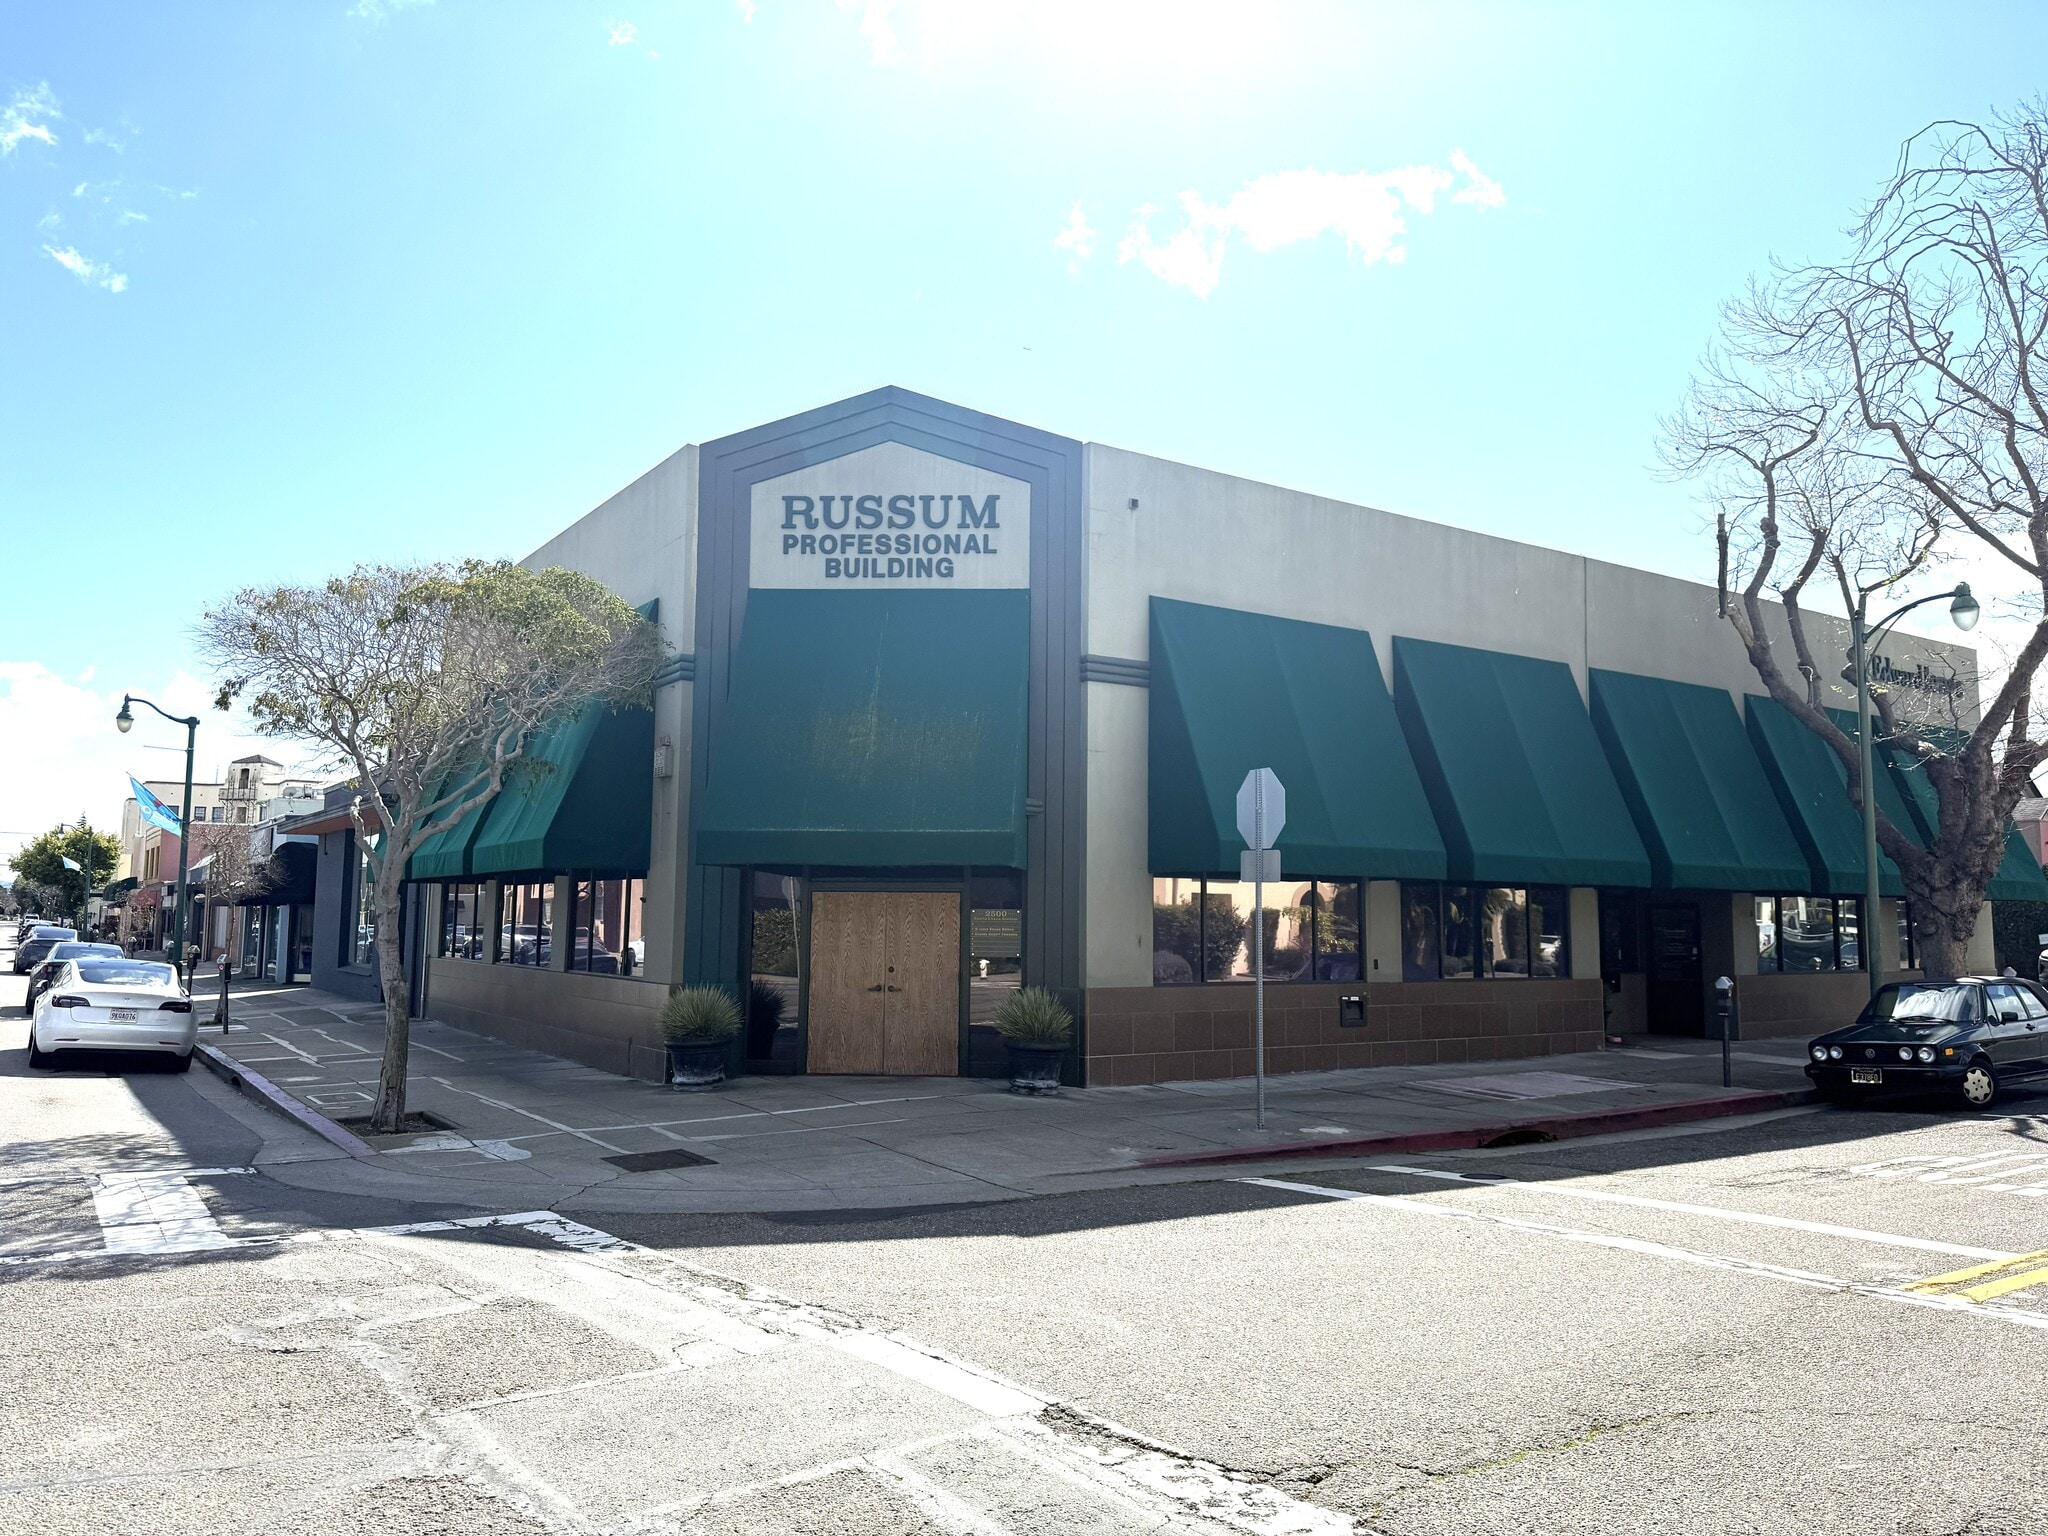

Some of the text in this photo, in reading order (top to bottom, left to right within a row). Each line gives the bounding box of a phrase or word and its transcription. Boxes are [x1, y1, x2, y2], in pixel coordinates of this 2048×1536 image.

[781, 494, 1000, 529] RUSSUM
[782, 534, 998, 555] PROFESSIONAL
[825, 557, 954, 578] BUILDING
